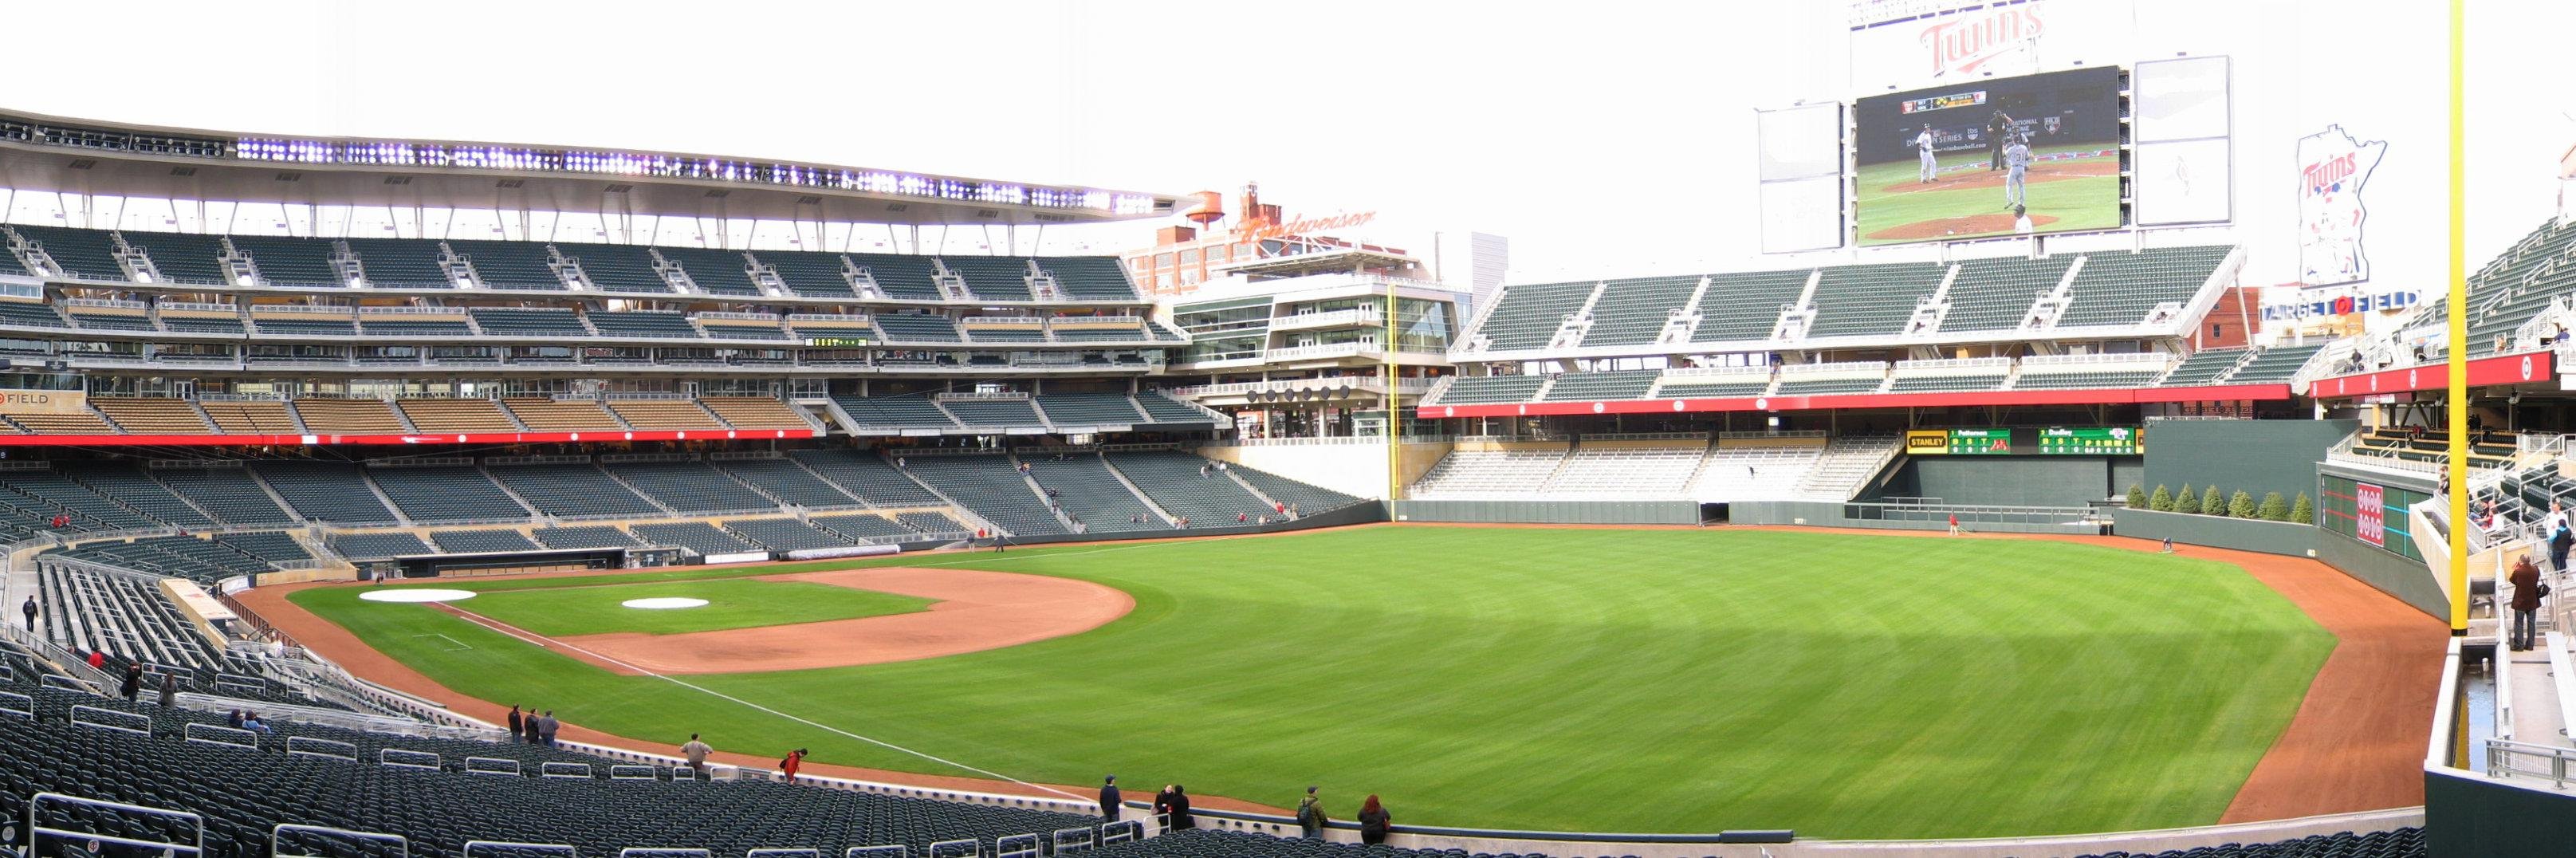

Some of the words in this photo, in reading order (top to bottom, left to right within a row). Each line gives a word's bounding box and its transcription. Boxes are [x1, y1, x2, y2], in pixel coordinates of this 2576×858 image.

[1920, 3, 2045, 75] Twins
[2303, 152, 2356, 199] Twins
[2259, 299, 2335, 321] TARGET
[2355, 290, 2419, 312] FIELD
[7, 394, 49, 404] FIELD
[1911, 438, 1944, 447] STANLEY
